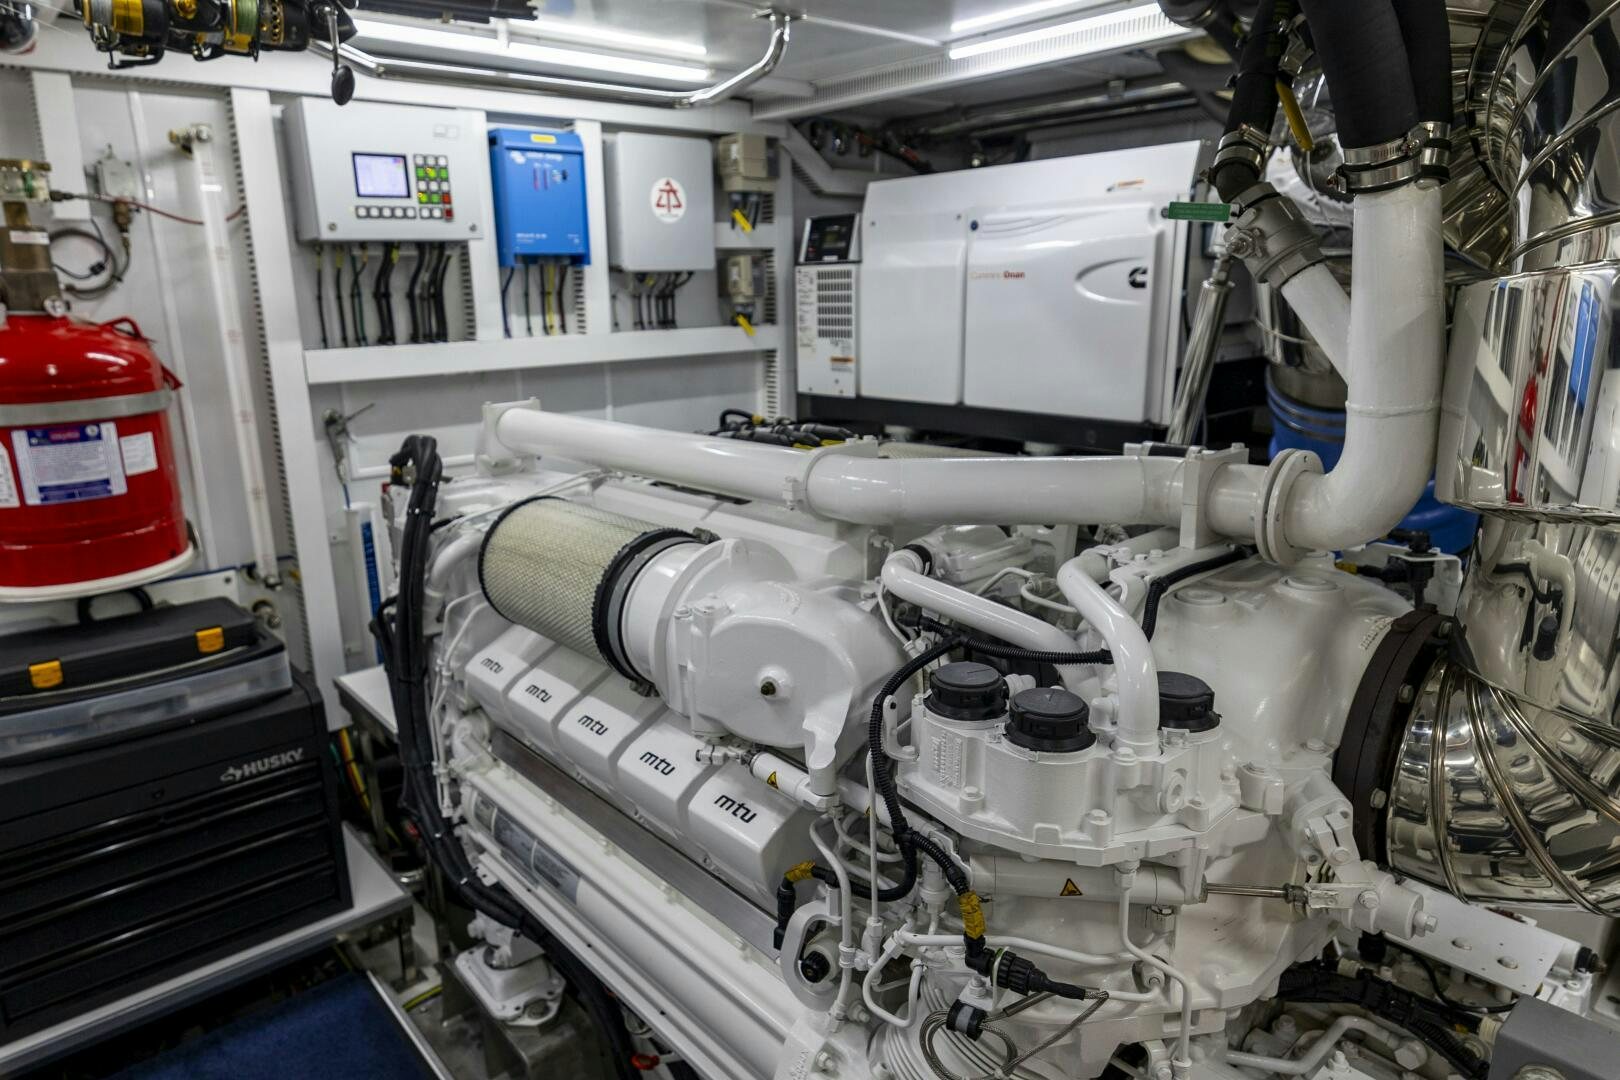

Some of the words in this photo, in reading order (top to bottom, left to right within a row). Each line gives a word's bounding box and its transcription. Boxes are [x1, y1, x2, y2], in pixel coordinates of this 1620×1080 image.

[480, 656, 504, 675] mtu
[525, 684, 552, 703] mtu
[577, 714, 609, 736] mtu
[242, 747, 303, 777] HUSKY
[640, 751, 676, 776] mtu
[714, 794, 757, 824] mtu
